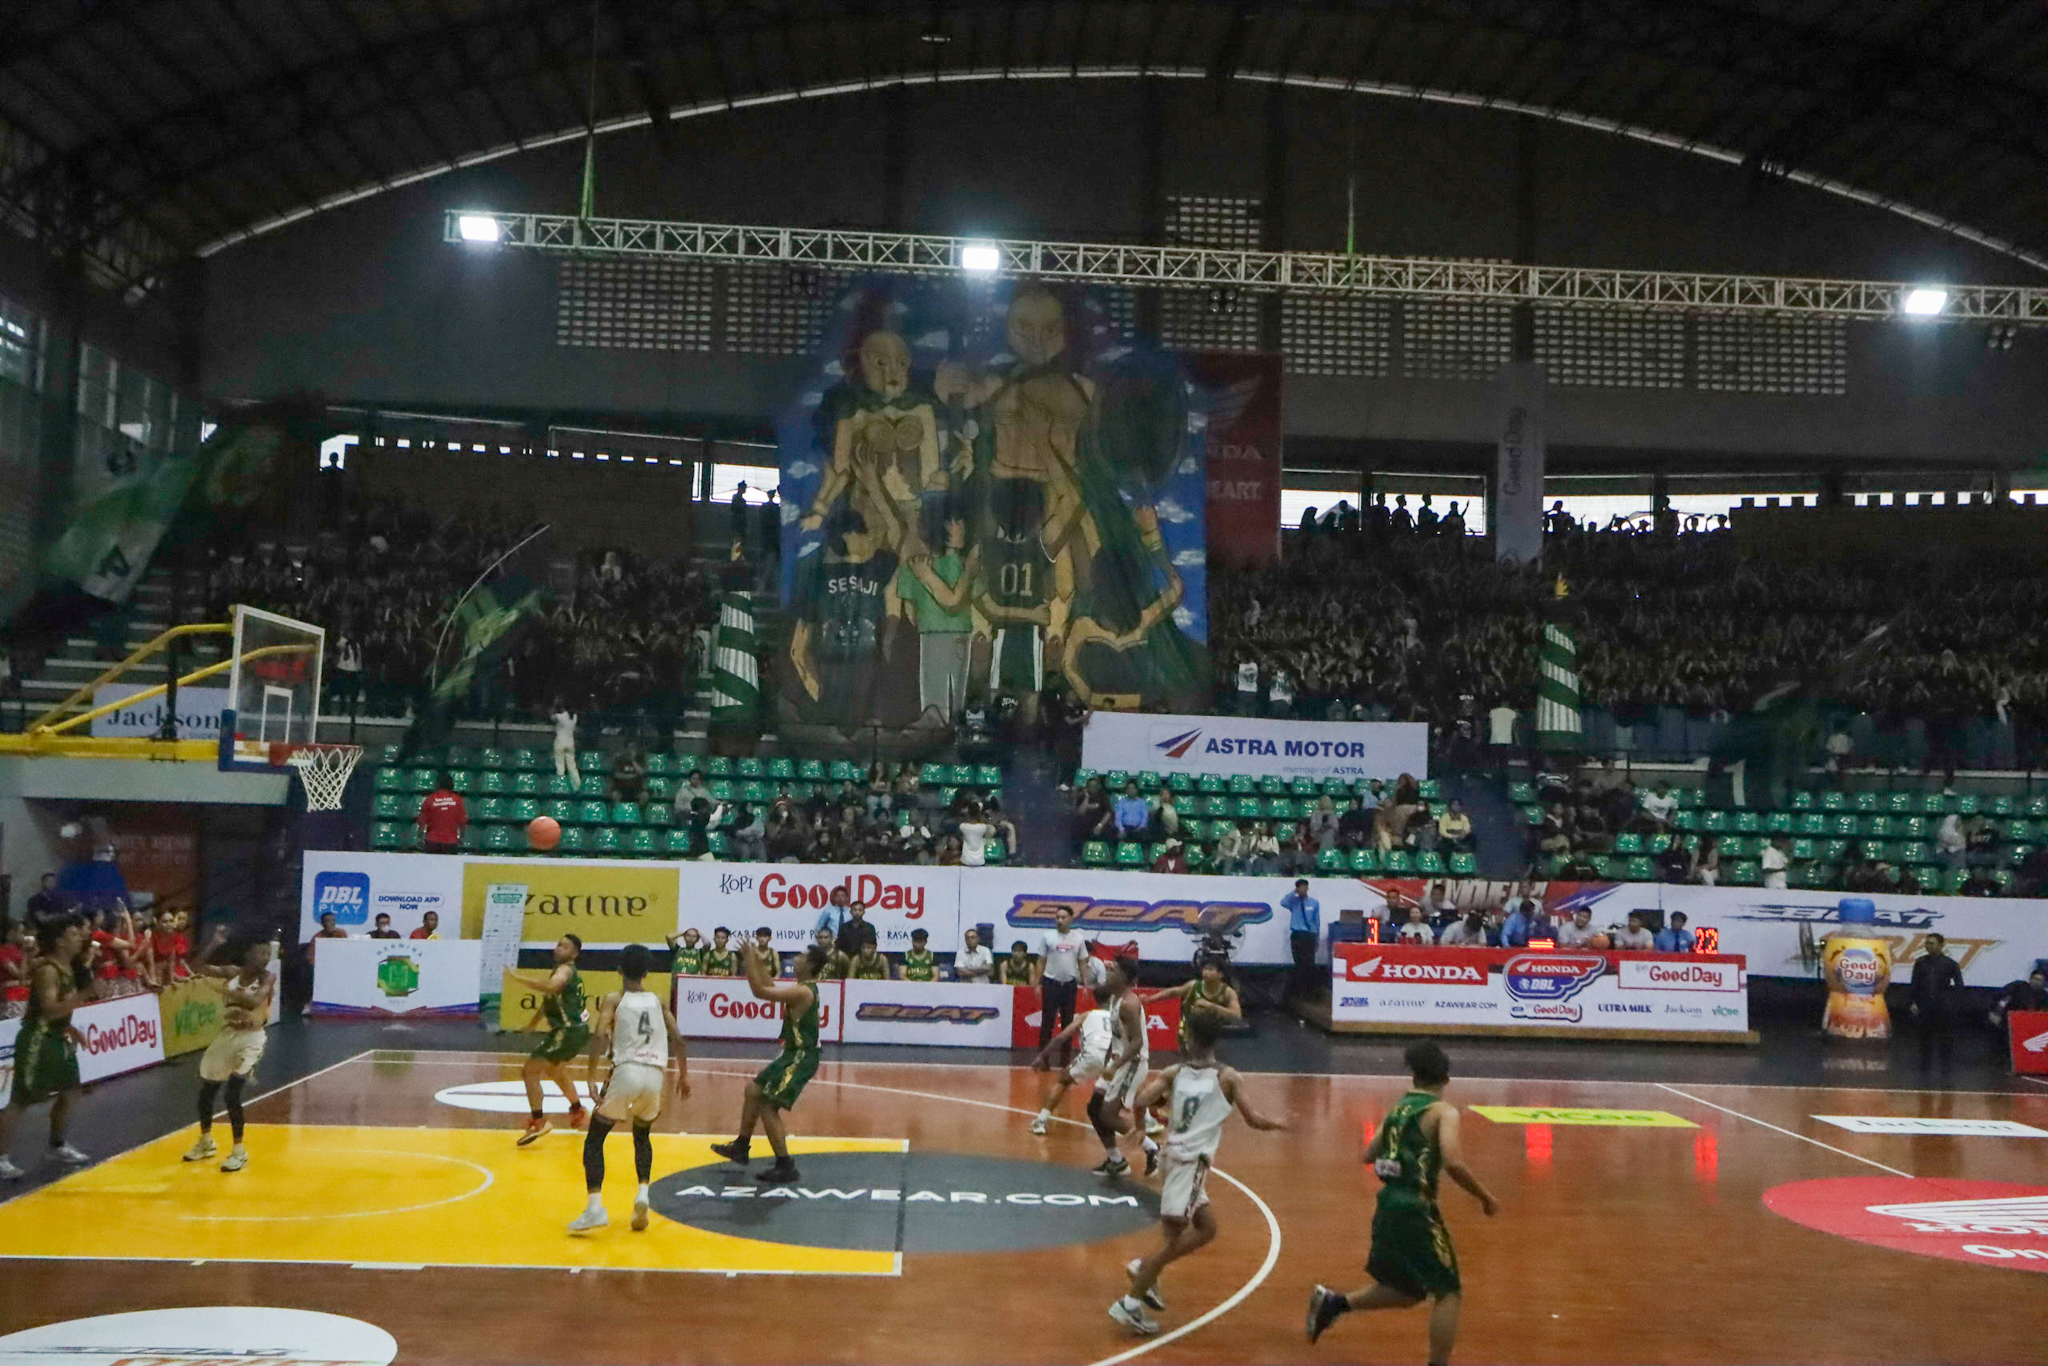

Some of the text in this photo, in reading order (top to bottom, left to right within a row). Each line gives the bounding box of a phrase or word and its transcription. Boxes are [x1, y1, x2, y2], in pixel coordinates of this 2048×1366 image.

[1000, 562, 1033, 597] 01
[1205, 737, 1366, 758] ASTRA MOTOR
[1332, 767, 1364, 775] ASTRA
[319, 886, 363, 904] DBL
[378, 895, 423, 904] DOWNLOAD
[319, 904, 360, 914] PLAY
[399, 903, 418, 911] NOW
[776, 930, 808, 940] HIDUP
[886, 930, 909, 940] RASA
[1531, 965, 1581, 974] HONDA
[1839, 958, 1878, 972] Good
[1381, 964, 1482, 981] HONDA
[1843, 969, 1874, 984] Day
[1530, 978, 1555, 991] DBL
[1598, 1003, 1652, 1014] ULTRA MILK
[675, 1184, 1139, 1208] AZAWEAR.COM
